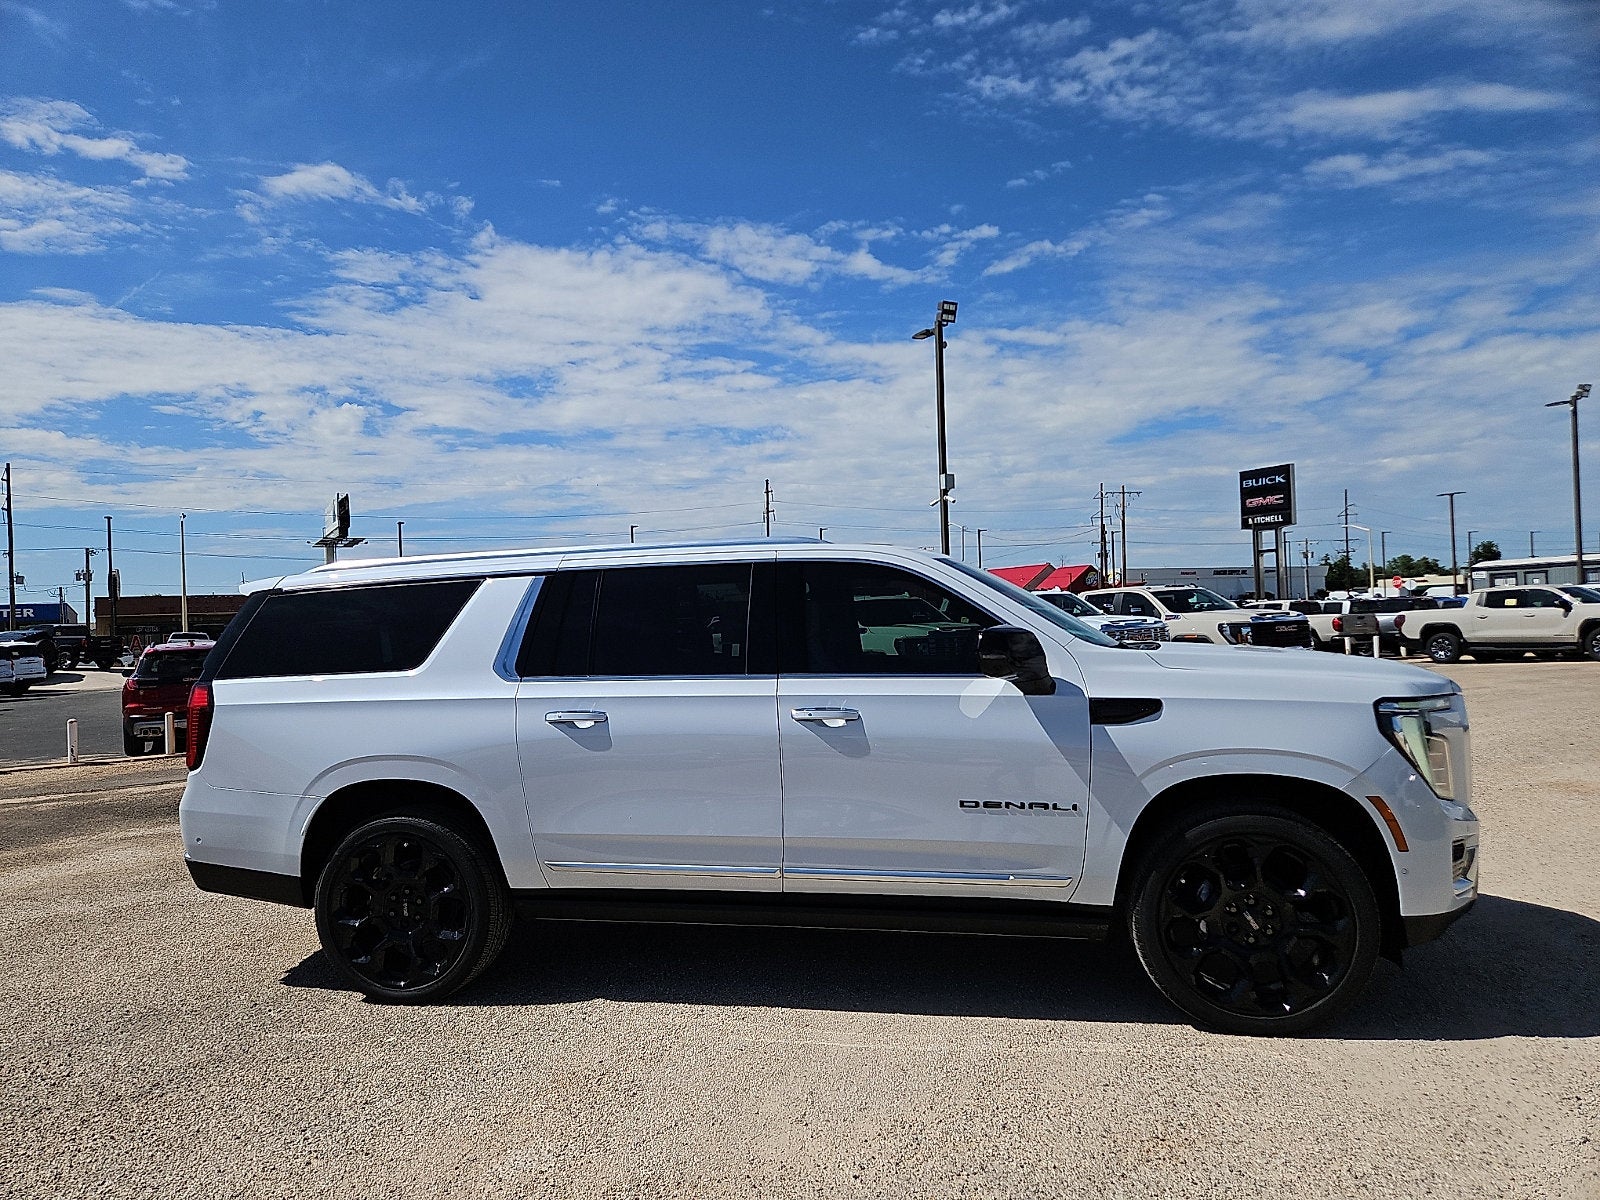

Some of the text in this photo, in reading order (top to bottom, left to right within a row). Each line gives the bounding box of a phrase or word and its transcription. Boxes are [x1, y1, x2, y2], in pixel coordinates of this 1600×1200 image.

[1243, 474, 1286, 487] BUICK
[1246, 494, 1284, 507] GMC
[959, 799, 1078, 812] DENALI
